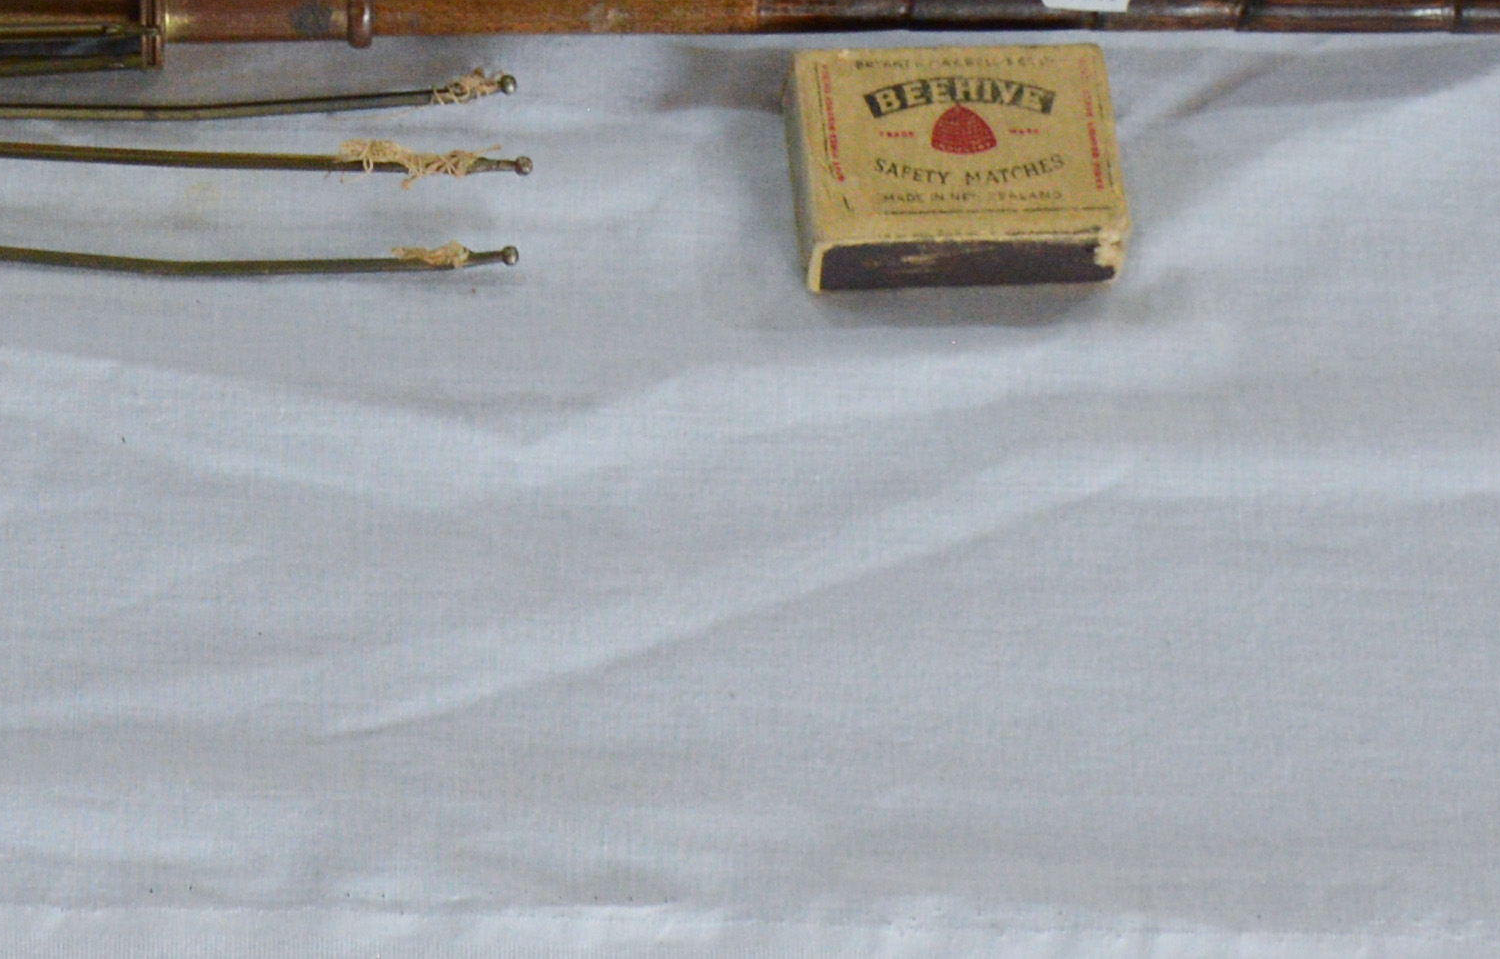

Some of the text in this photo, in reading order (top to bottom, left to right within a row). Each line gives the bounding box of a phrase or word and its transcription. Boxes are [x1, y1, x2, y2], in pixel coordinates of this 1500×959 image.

[871, 78, 1047, 115] BEEHIVE
[873, 152, 1066, 186] SAFETY MATCHES
[883, 192, 922, 202] MADE
[930, 192, 945, 202] IN
[988, 190, 1063, 202] EALAND
